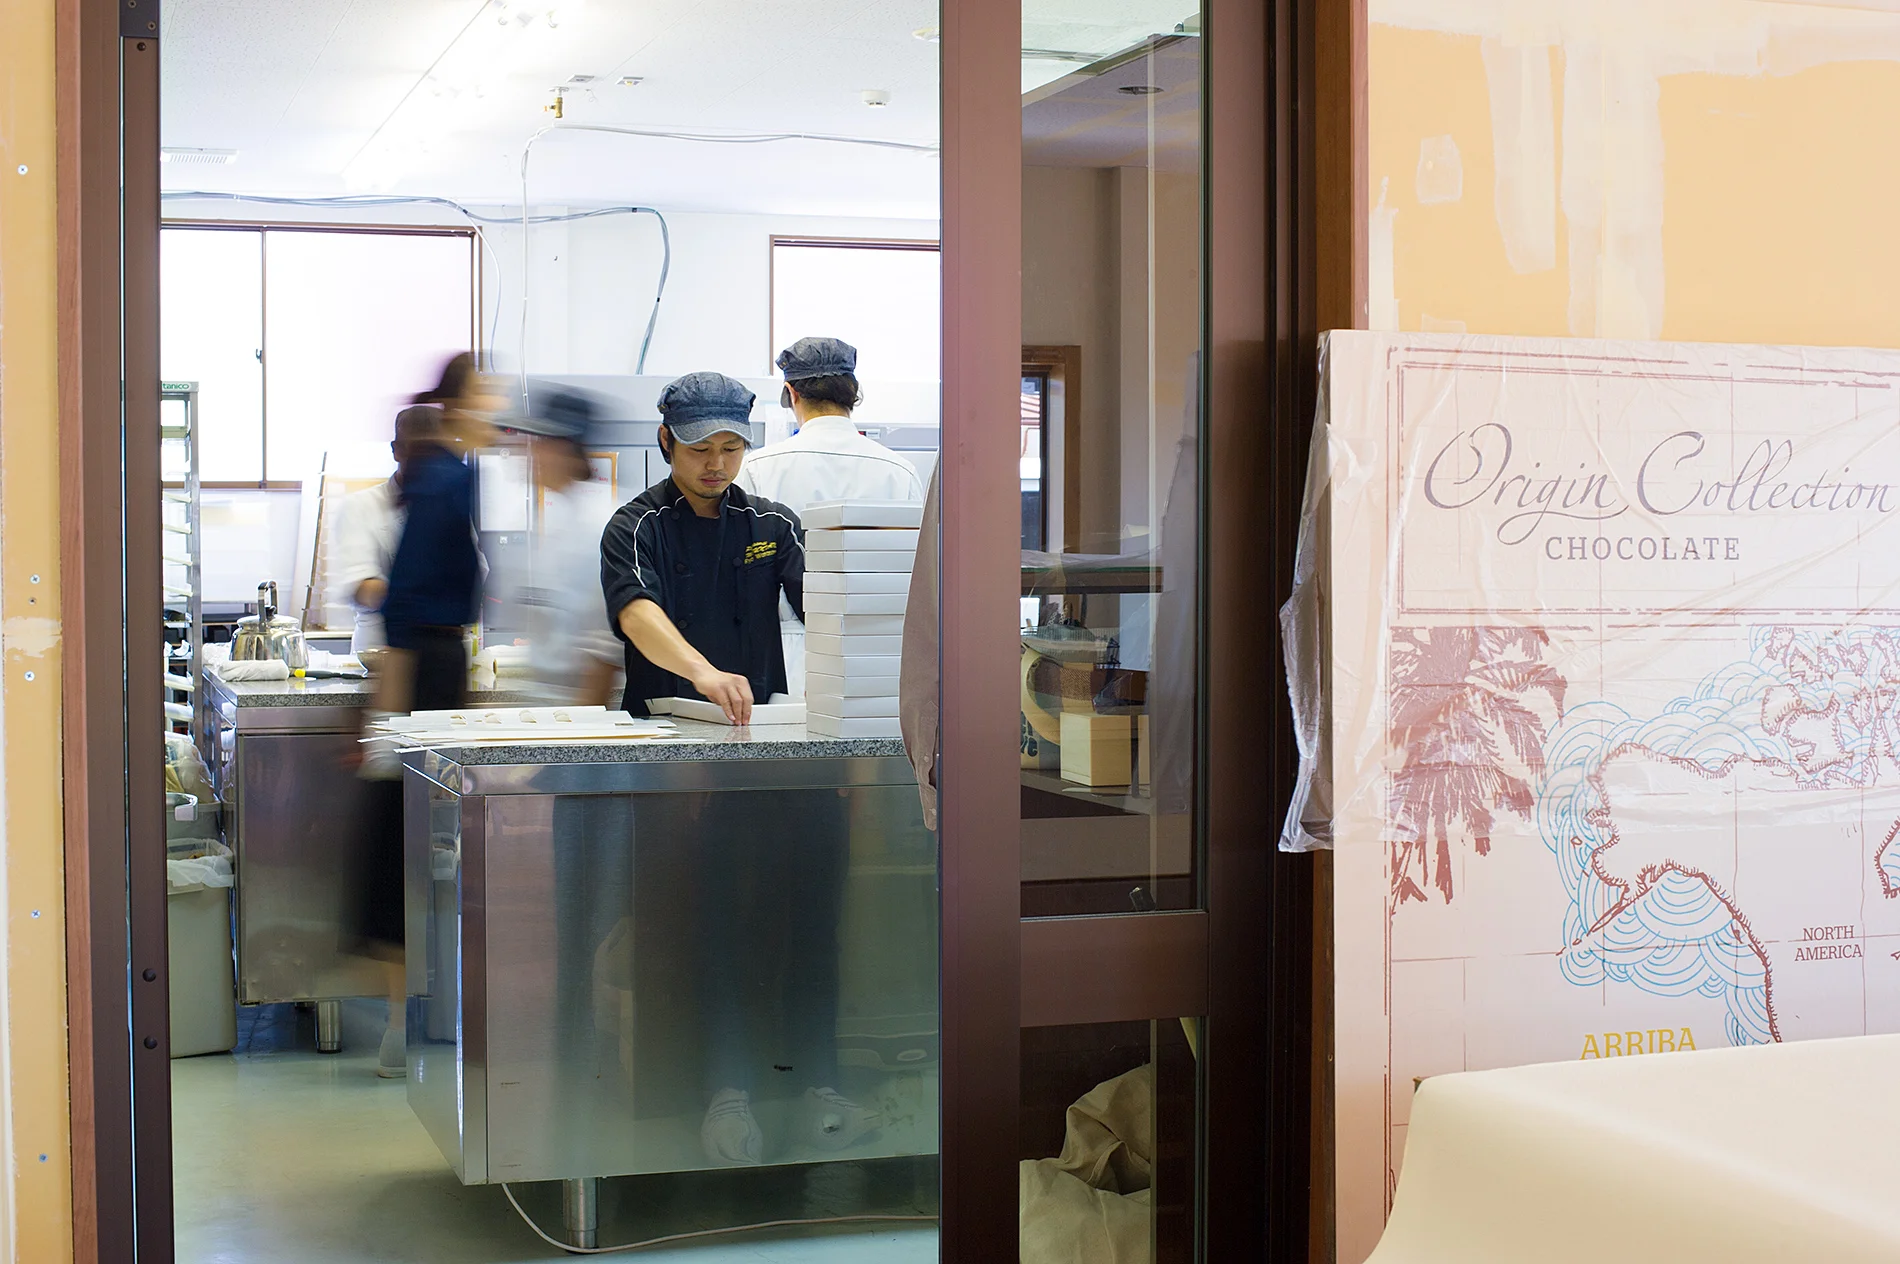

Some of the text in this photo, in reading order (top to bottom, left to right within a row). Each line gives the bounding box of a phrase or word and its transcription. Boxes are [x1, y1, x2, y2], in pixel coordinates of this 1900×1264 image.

[1424, 422, 1896, 545] Origin Collection
[1545, 536, 1740, 560] CHOCOLATE
[1803, 925, 1854, 941] NORTH
[1795, 944, 1863, 961] AMERICA
[1579, 1027, 1697, 1060] ARRIBA
